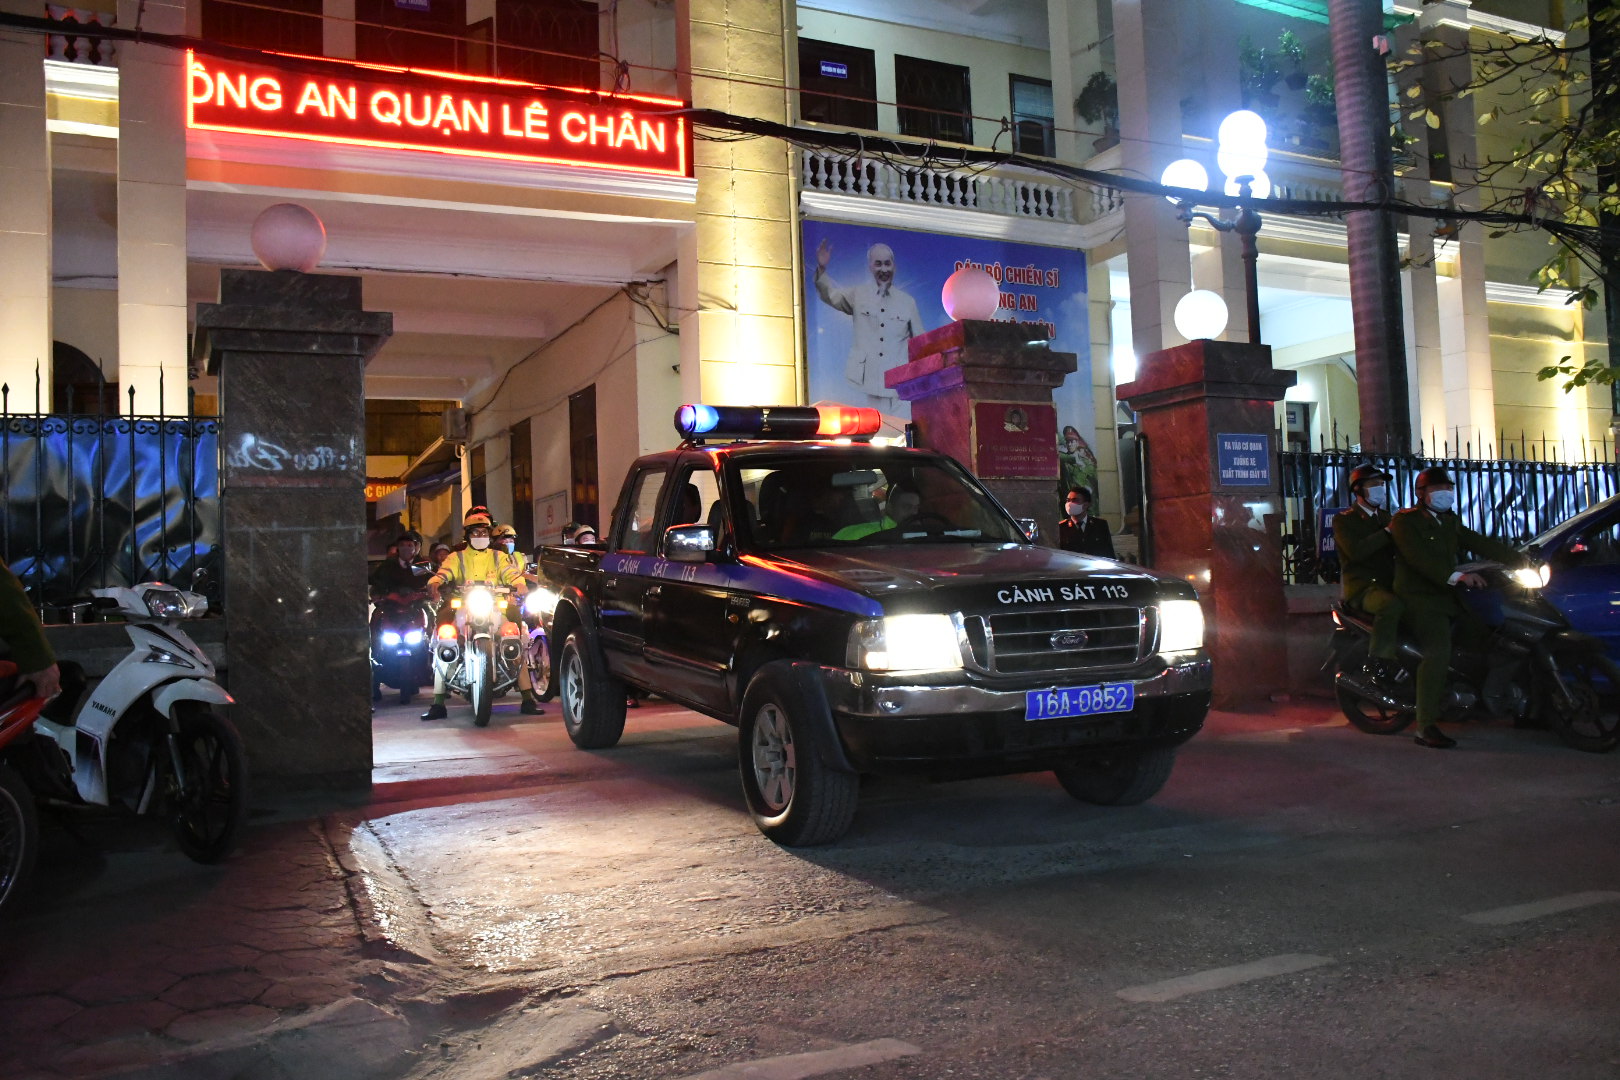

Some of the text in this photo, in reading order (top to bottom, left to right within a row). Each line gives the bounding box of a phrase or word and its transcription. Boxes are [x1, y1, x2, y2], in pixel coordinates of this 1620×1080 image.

[296, 82, 356, 120] AN
[369, 90, 489, 136] QUẬN
[503, 101, 549, 140] LÊ
[561, 111, 665, 152] CHÂN
[1005, 264, 1043, 287] CHIẾN
[1045, 268, 1059, 288] SĨ
[1019, 294, 1037, 312] AN
[617, 555, 697, 581] CẢNH SÁT 113
[997, 583, 1129, 604] CẢNH SÁT 113
[1061, 635, 1080, 645] Ford
[92, 700, 116, 718] YAMAHA
[1036, 686, 1128, 717] 16A-0852
